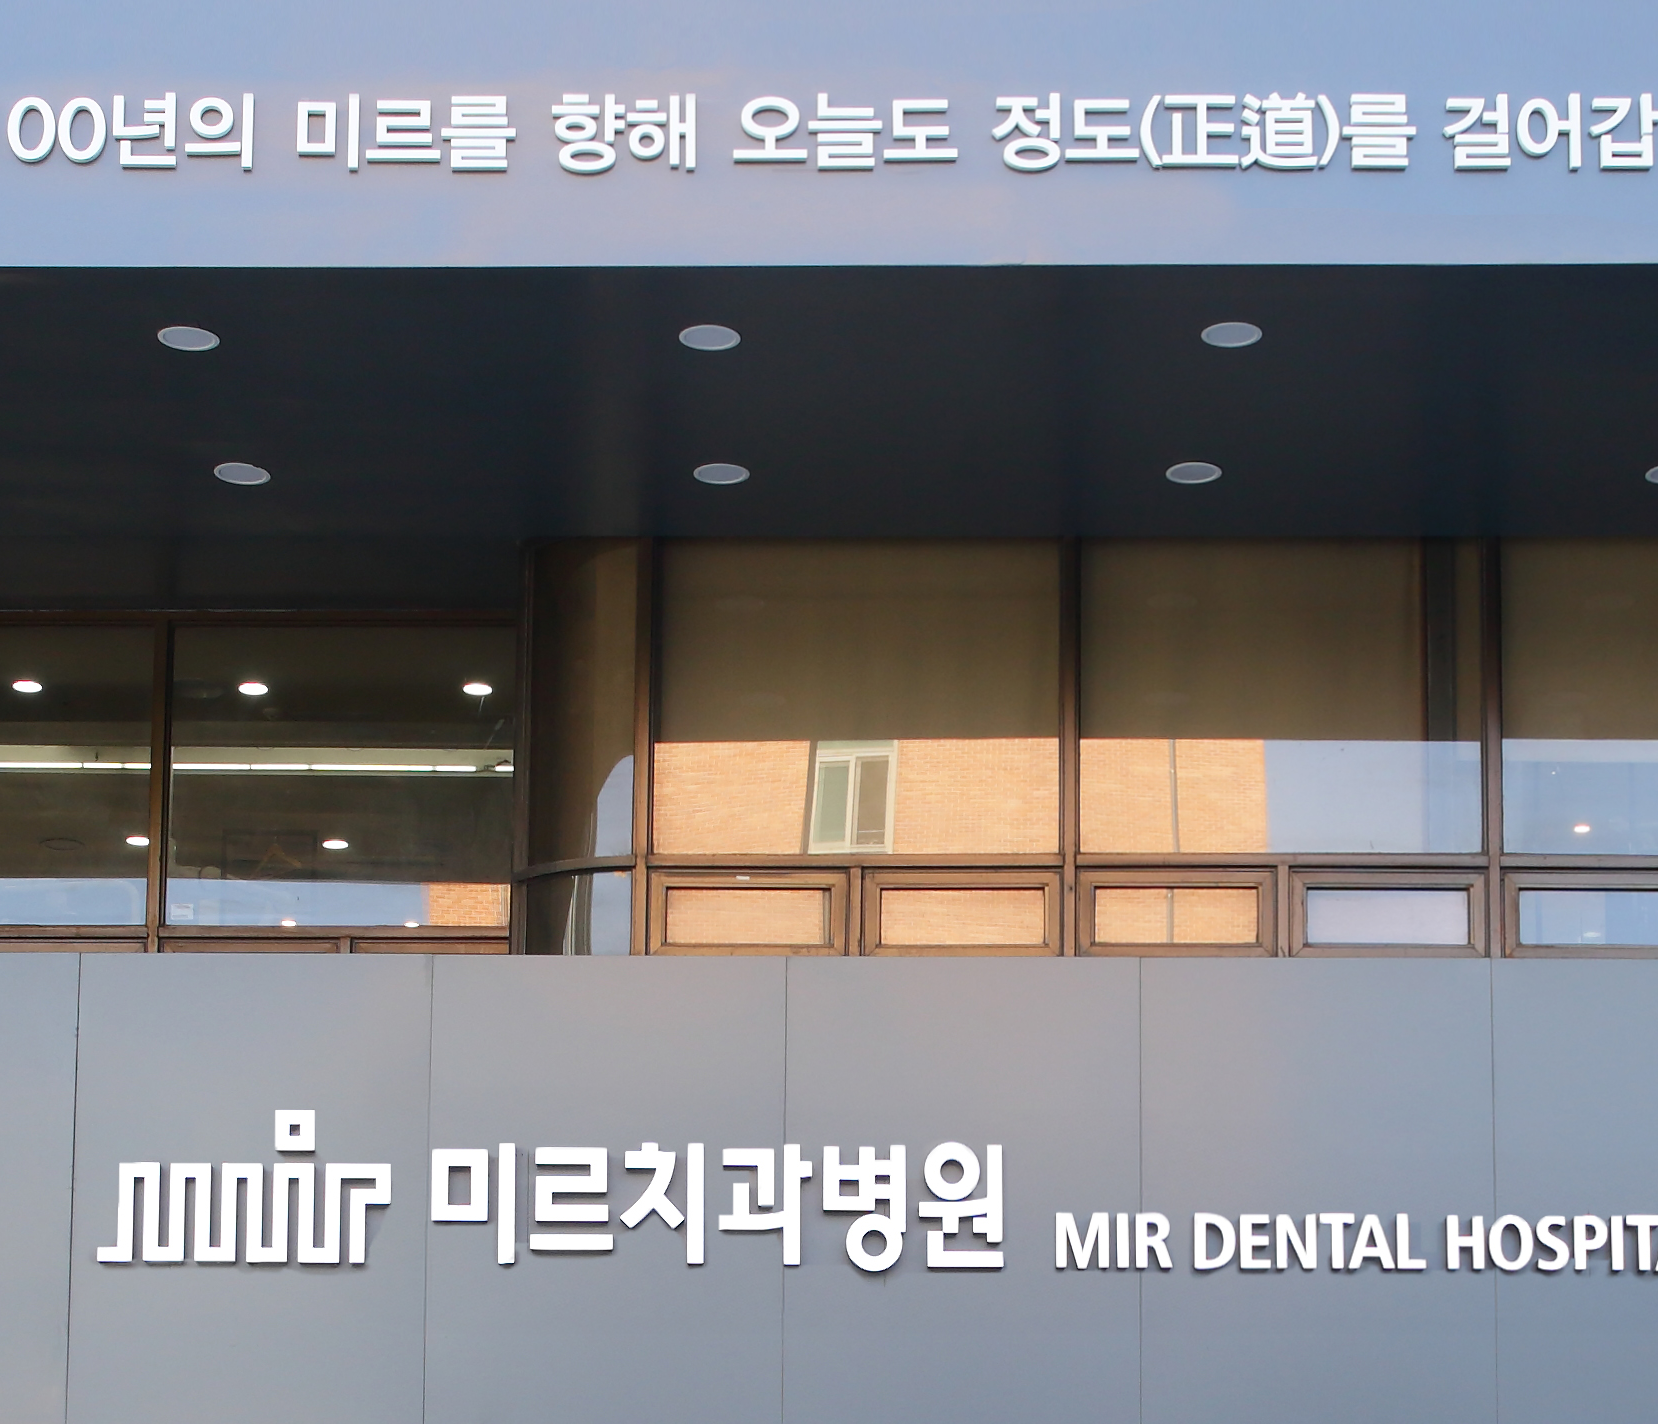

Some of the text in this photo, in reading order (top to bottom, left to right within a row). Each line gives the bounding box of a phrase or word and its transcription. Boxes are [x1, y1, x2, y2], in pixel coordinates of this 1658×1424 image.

[296, 93, 516, 171] 미르를
[551, 93, 696, 173] 향해
[731, 93, 957, 171] 오늘도
[991, 92, 1417, 172] 정도(正道)를
[430, 1140, 1007, 1273] 미르치과병원
[1054, 1211, 1173, 1270] MIR
[1193, 1211, 1428, 1272] DENTAL
